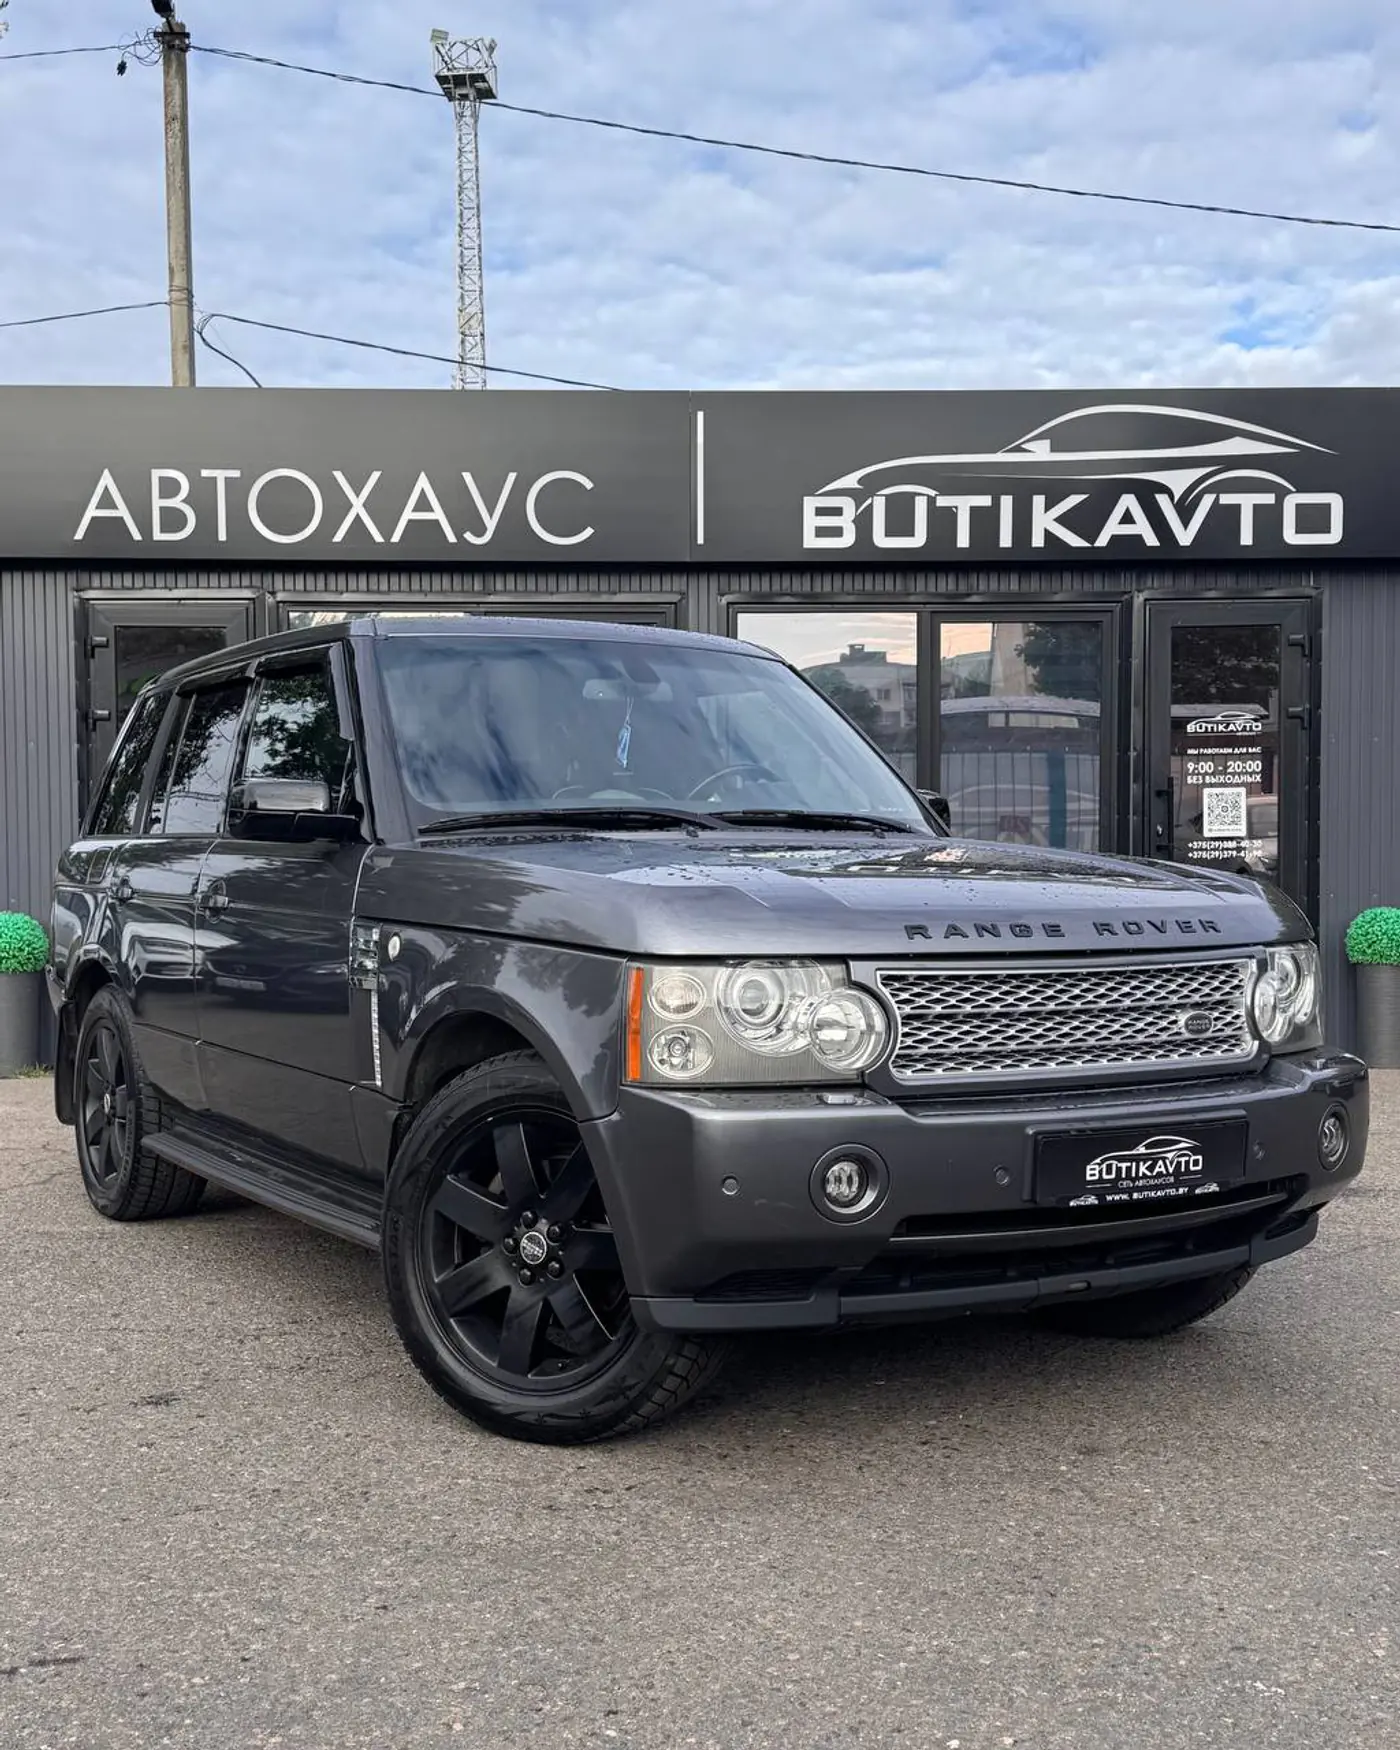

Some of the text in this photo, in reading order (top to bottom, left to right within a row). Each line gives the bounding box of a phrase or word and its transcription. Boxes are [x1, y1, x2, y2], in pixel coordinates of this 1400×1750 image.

[73, 468, 595, 546] АВТОХАУС
[803, 492, 1344, 549] BUTIKAVTO
[1186, 722, 1262, 733] BUTIKAVTO
[1187, 761, 1214, 774] 9:00
[1227, 760, 1262, 773] 20:00
[1187, 773, 1262, 785] БЕЗ ВЫХОДНЫХ
[904, 918, 1222, 940] RANGE ROVER
[1085, 1155, 1203, 1181] BUTIKAVTO
[1132, 1187, 1189, 1200] BUTIKAVTO.BY
